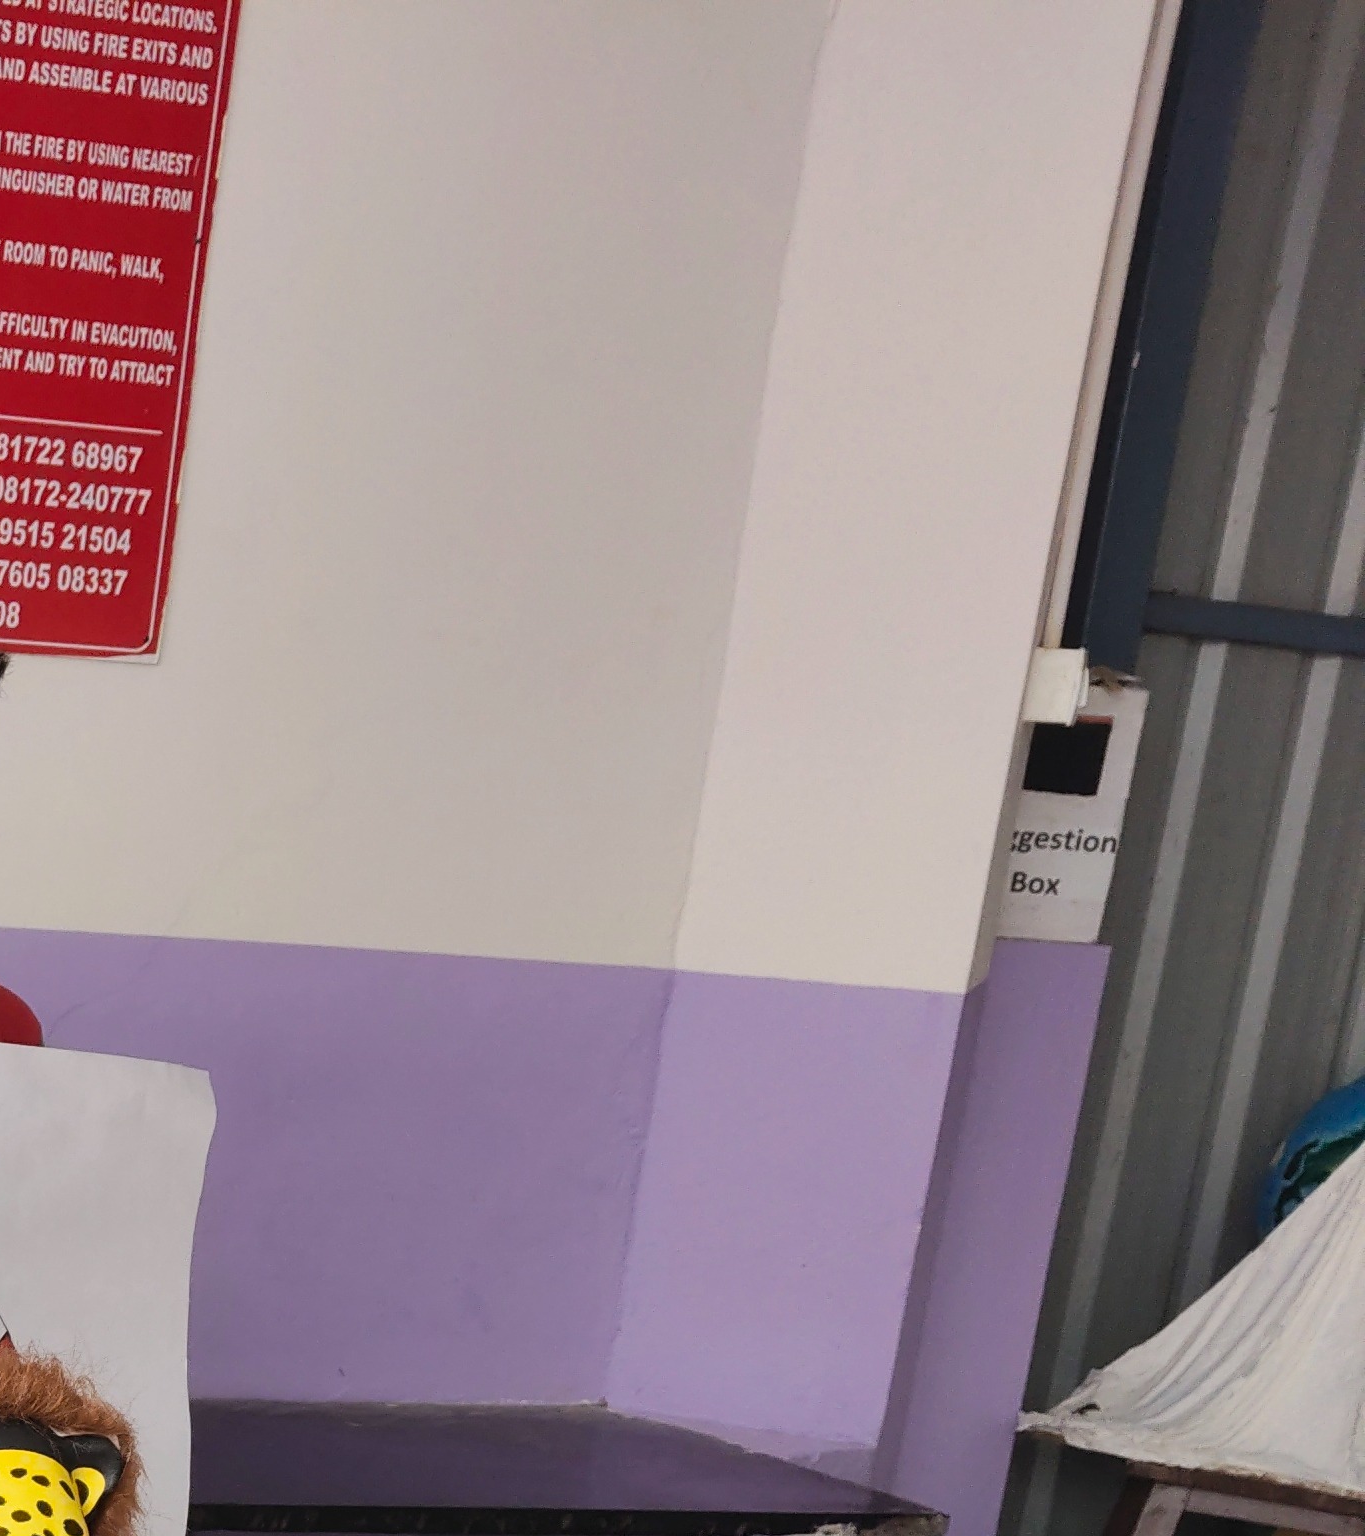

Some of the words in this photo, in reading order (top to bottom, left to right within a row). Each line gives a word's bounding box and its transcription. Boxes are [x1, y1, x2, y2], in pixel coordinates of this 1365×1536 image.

[132, 0, 217, 34] LOCATIONS.
[15, 21, 38, 46] BY
[40, 25, 90, 53] USING
[92, 31, 129, 59] FIRE
[131, 36, 177, 66] EXITS
[180, 44, 213, 70] AND
[28, 61, 113, 94] ASSEMBLE
[114, 72, 137, 97] AT
[140, 75, 209, 106] VARIOUS
[5, 130, 33, 157] THE
[33, 134, 64, 161] FIRE
[67, 139, 87, 163] BY
[88, 141, 130, 169] USING
[131, 147, 194, 177] NEAREST
[77, 176, 99, 201] OR
[101, 179, 151, 208] WATER
[152, 187, 194, 212] FROM
[3, 239, 46, 267] ROOM
[49, 244, 68, 269] TO
[70, 247, 118, 280] PANIC,
[120, 253, 165, 285] WALK,
[70, 319, 89, 343] IN
[90, 321, 178, 357] EVACUTION,
[24, 350, 55, 374] AND
[59, 354, 86, 377] TRY
[89, 356, 108, 380] TO
[110, 359, 174, 387] ATTRACT
[71, 440, 143, 474] 68967
[60, 523, 131, 556] 21504
[57, 564, 128, 597] 08337
[1011, 871, 1061, 896] Box
